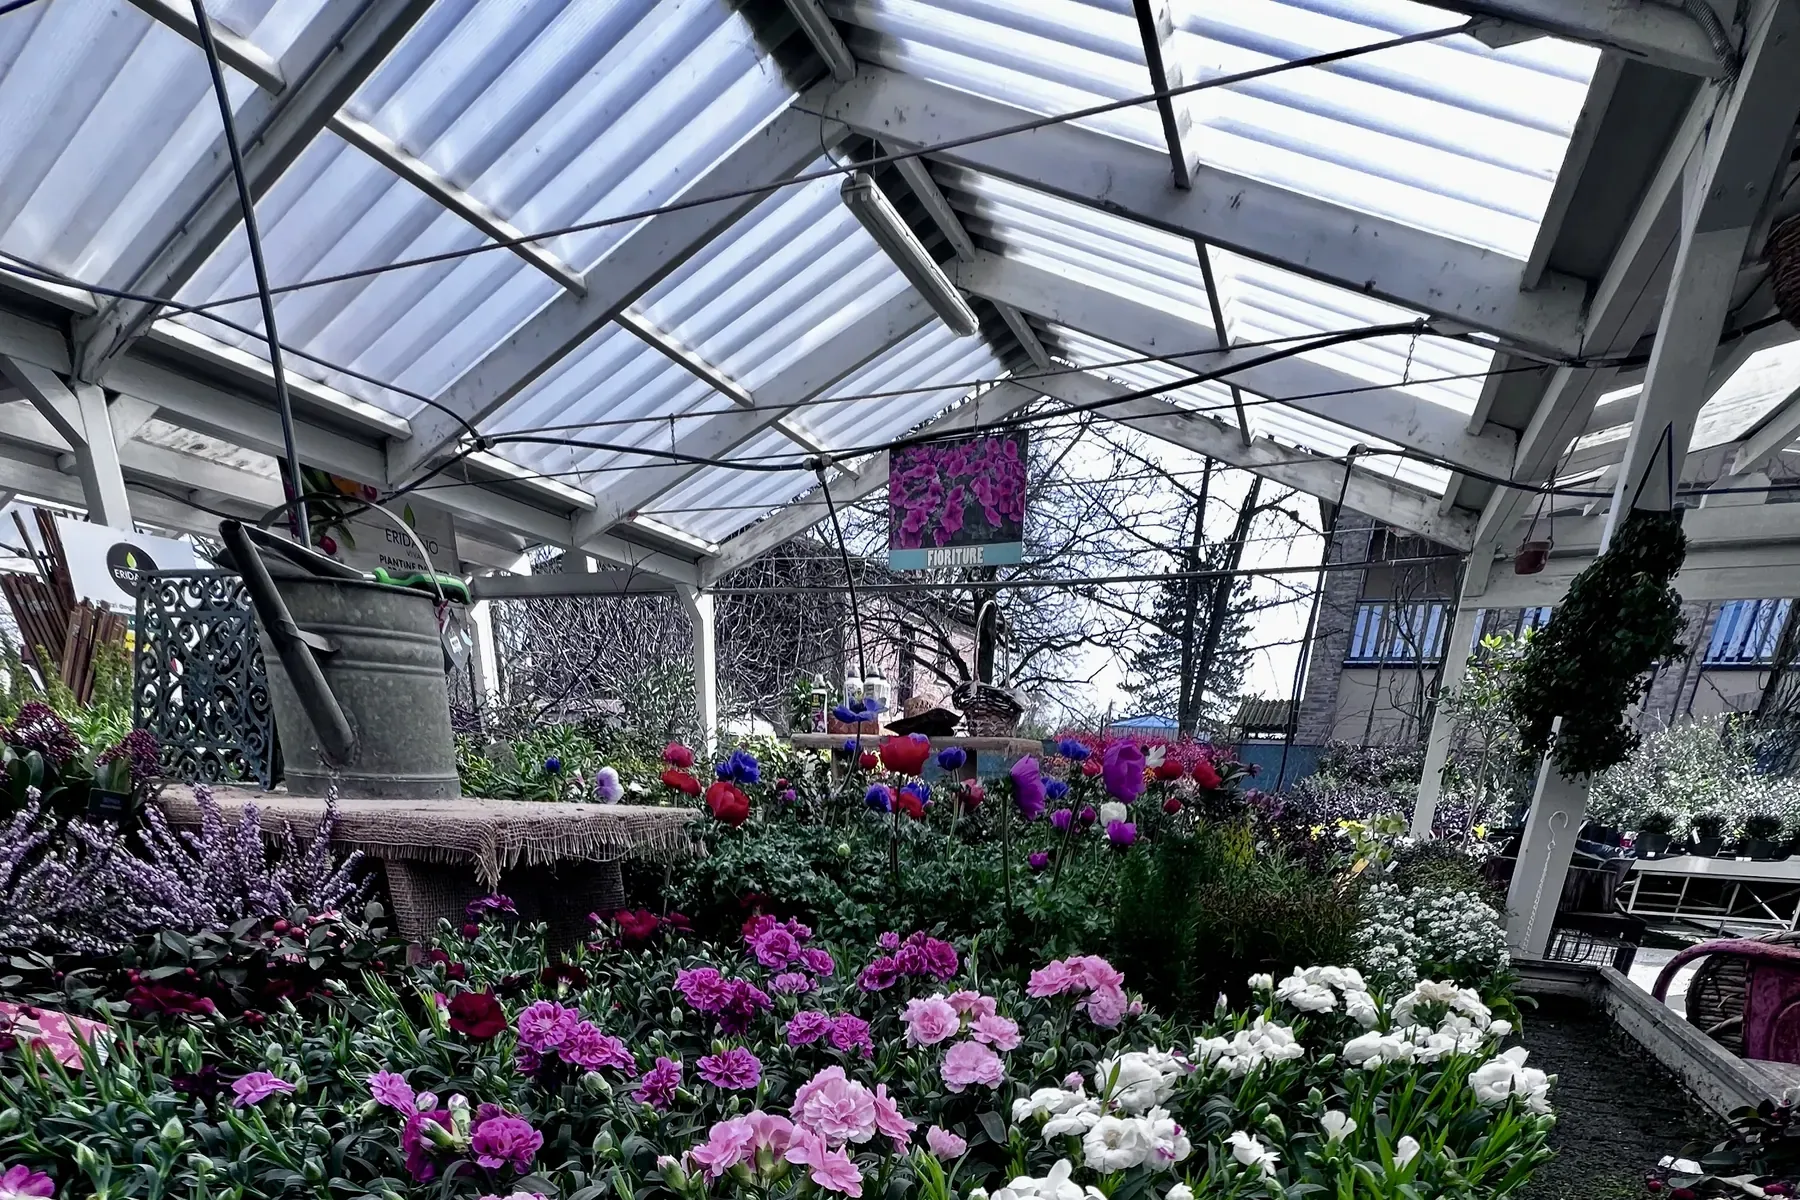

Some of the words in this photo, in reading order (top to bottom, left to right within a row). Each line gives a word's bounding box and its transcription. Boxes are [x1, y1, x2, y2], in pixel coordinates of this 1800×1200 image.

[406, 550, 425, 560] VIVA
[927, 547, 984, 566] FIORITURE
[114, 569, 139, 581] ERIDA
